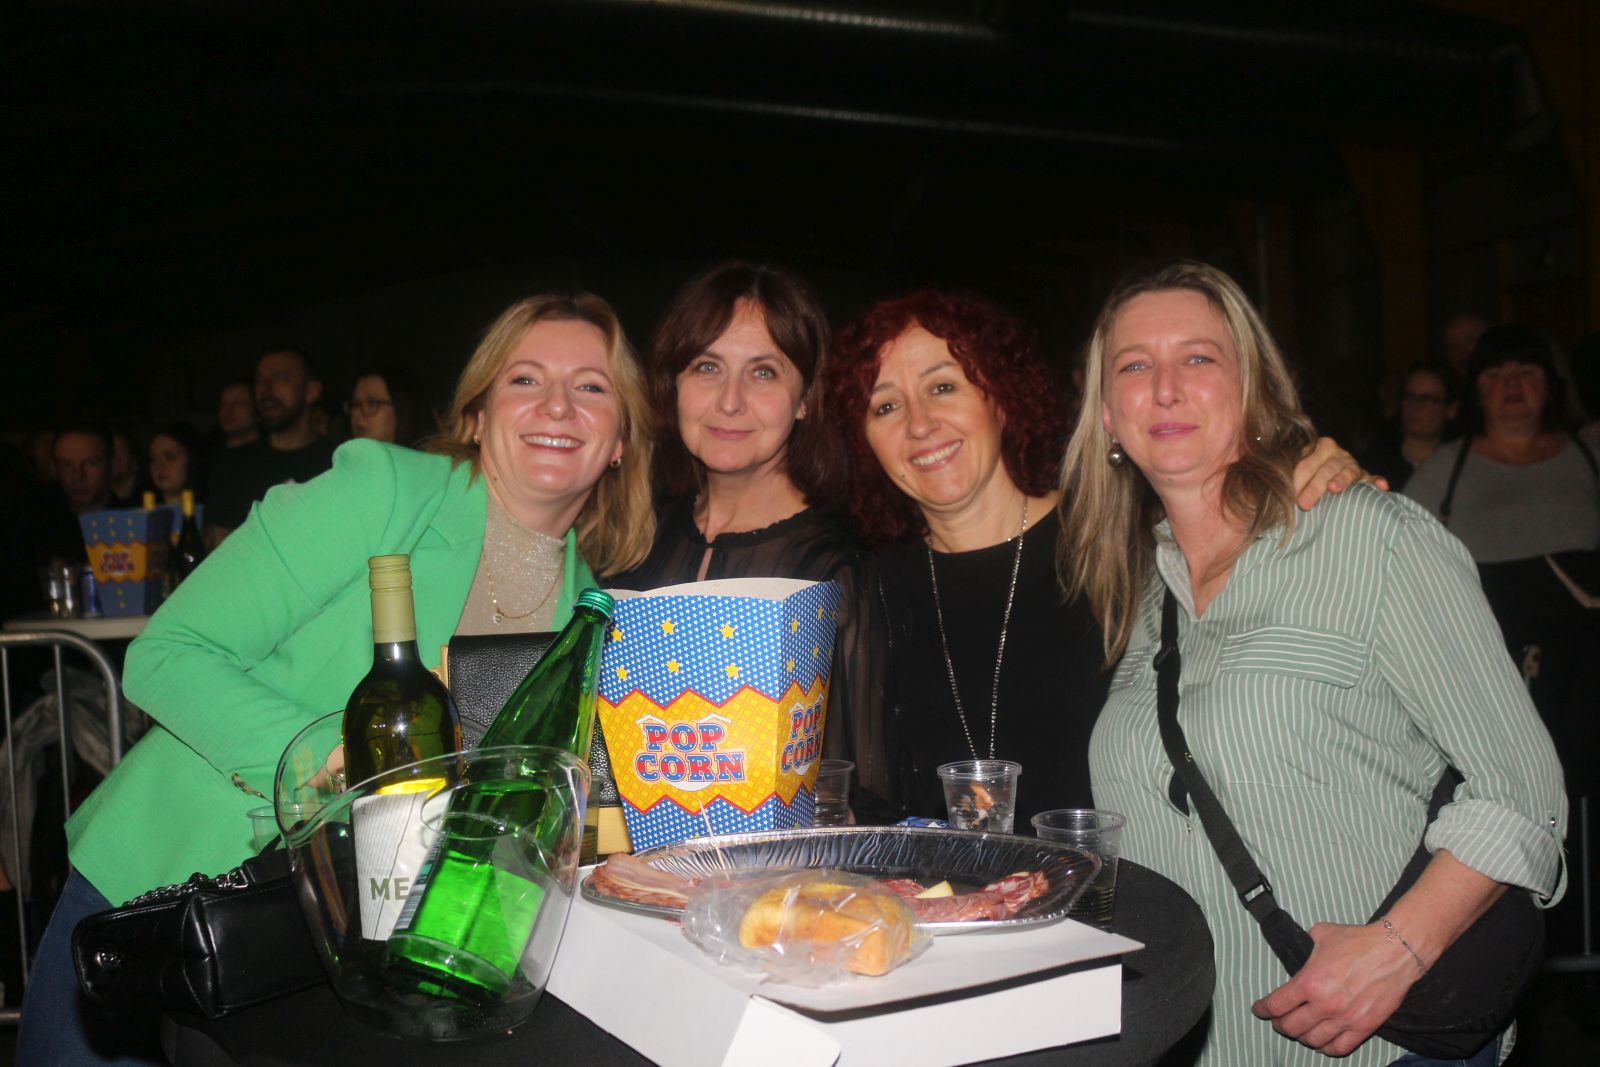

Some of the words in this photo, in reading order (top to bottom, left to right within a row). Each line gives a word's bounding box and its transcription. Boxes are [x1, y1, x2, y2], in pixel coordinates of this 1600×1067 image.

[643, 723, 724, 752] POP
[790, 702, 822, 741] POP
[635, 752, 745, 782] CORN
[781, 730, 822, 773] CORN
